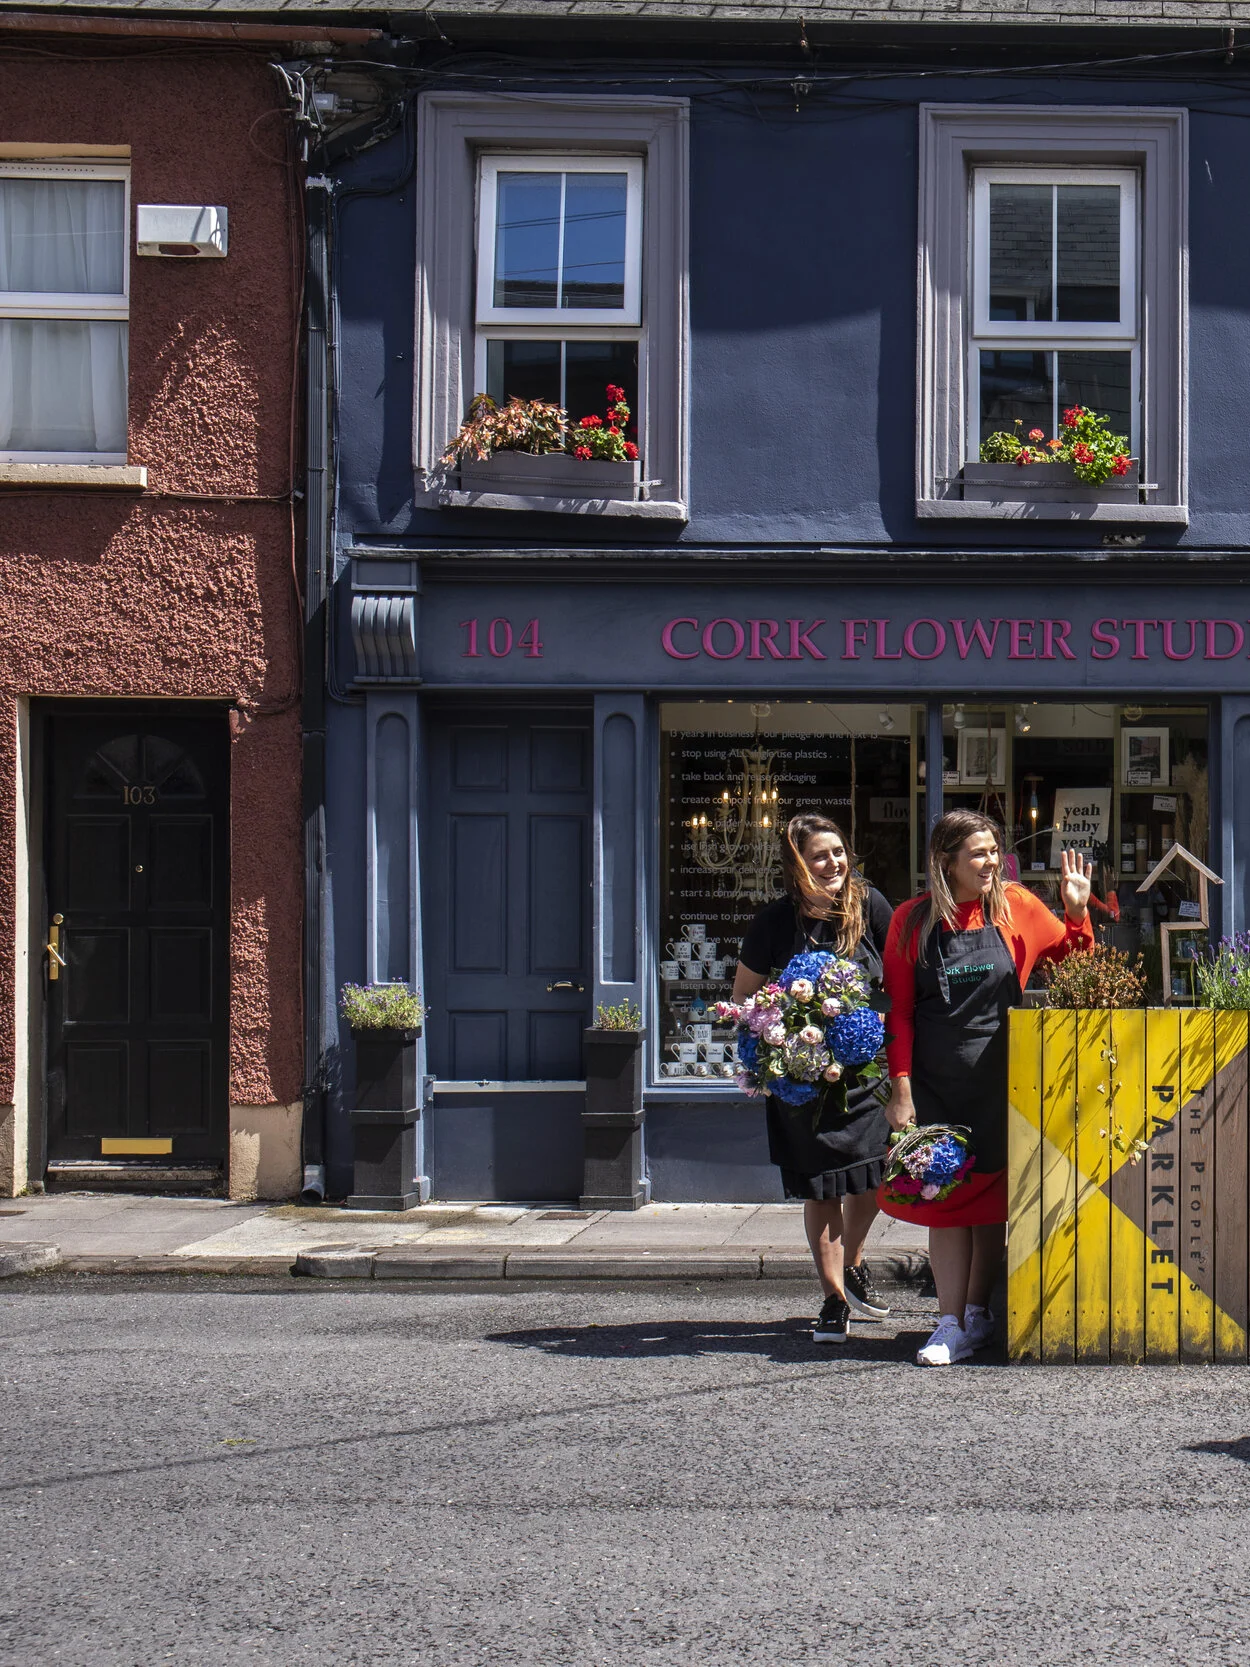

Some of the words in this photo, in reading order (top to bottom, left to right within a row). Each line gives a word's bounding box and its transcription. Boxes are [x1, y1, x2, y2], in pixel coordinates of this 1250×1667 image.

[458, 617, 544, 659] 104
[660, 616, 829, 661] CORK
[840, 616, 1077, 661] FLOWER
[718, 729, 754, 738] business
[681, 749, 702, 759] stop
[704, 749, 727, 760] using
[795, 749, 828, 760] plastics
[681, 772, 701, 781] take
[704, 772, 724, 781] back
[727, 772, 744, 781] and
[773, 773, 817, 784] packaging
[123, 785, 156, 805] 103
[681, 796, 711, 805] create
[778, 797, 794, 805] our
[796, 797, 822, 807] green
[824, 797, 852, 805] waste
[1063, 803, 1101, 820] yeah
[1062, 819, 1100, 835] baby
[680, 865, 718, 874] increase
[680, 889, 703, 897] start
[680, 912, 719, 921] continue
[720, 913, 731, 921] to
[945, 966, 961, 975] ork
[964, 963, 995, 973] Flower
[680, 982, 704, 990] listen
[951, 975, 982, 985] Studio
[1190, 1085, 1207, 1135] THE
[1151, 1085, 1175, 1295] PARKLET
